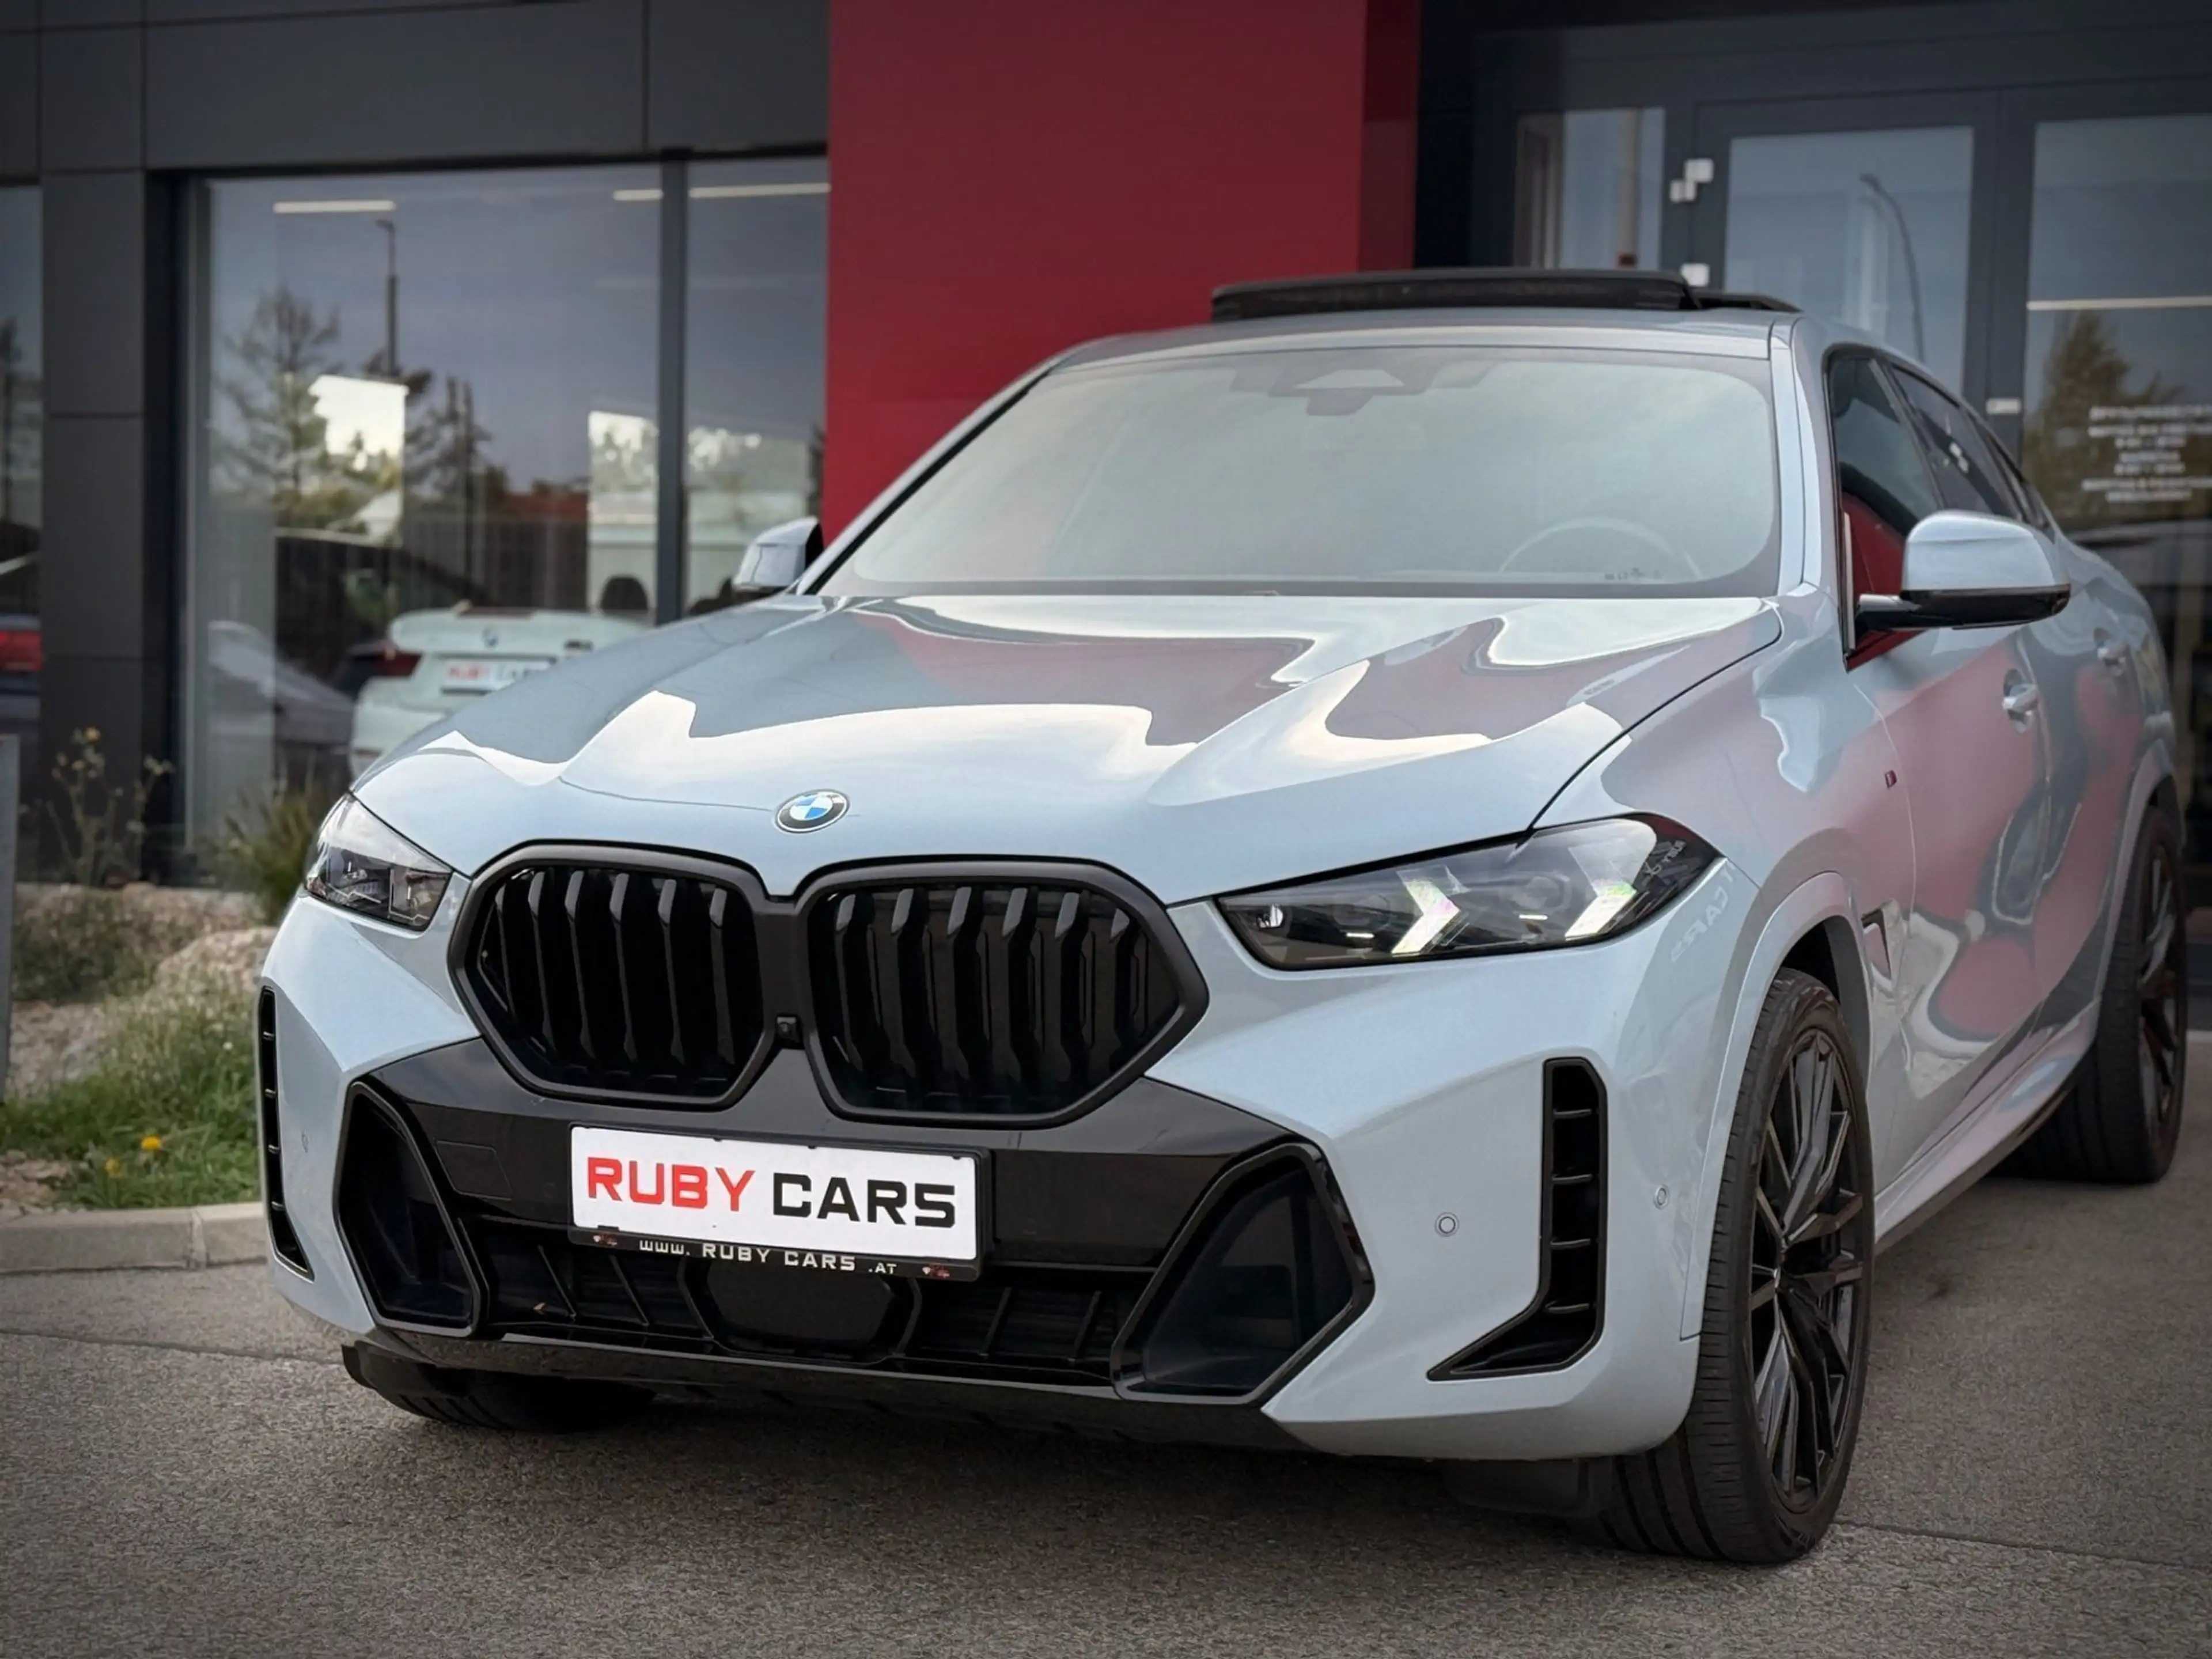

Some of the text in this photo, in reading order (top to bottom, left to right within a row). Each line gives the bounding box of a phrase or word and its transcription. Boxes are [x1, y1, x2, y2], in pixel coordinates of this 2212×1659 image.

[587, 1157, 955, 1228] RUBY CARS
[702, 1243, 770, 1263] RUBY
[784, 1250, 855, 1271] CARS
[868, 1262, 897, 1275] .AT
